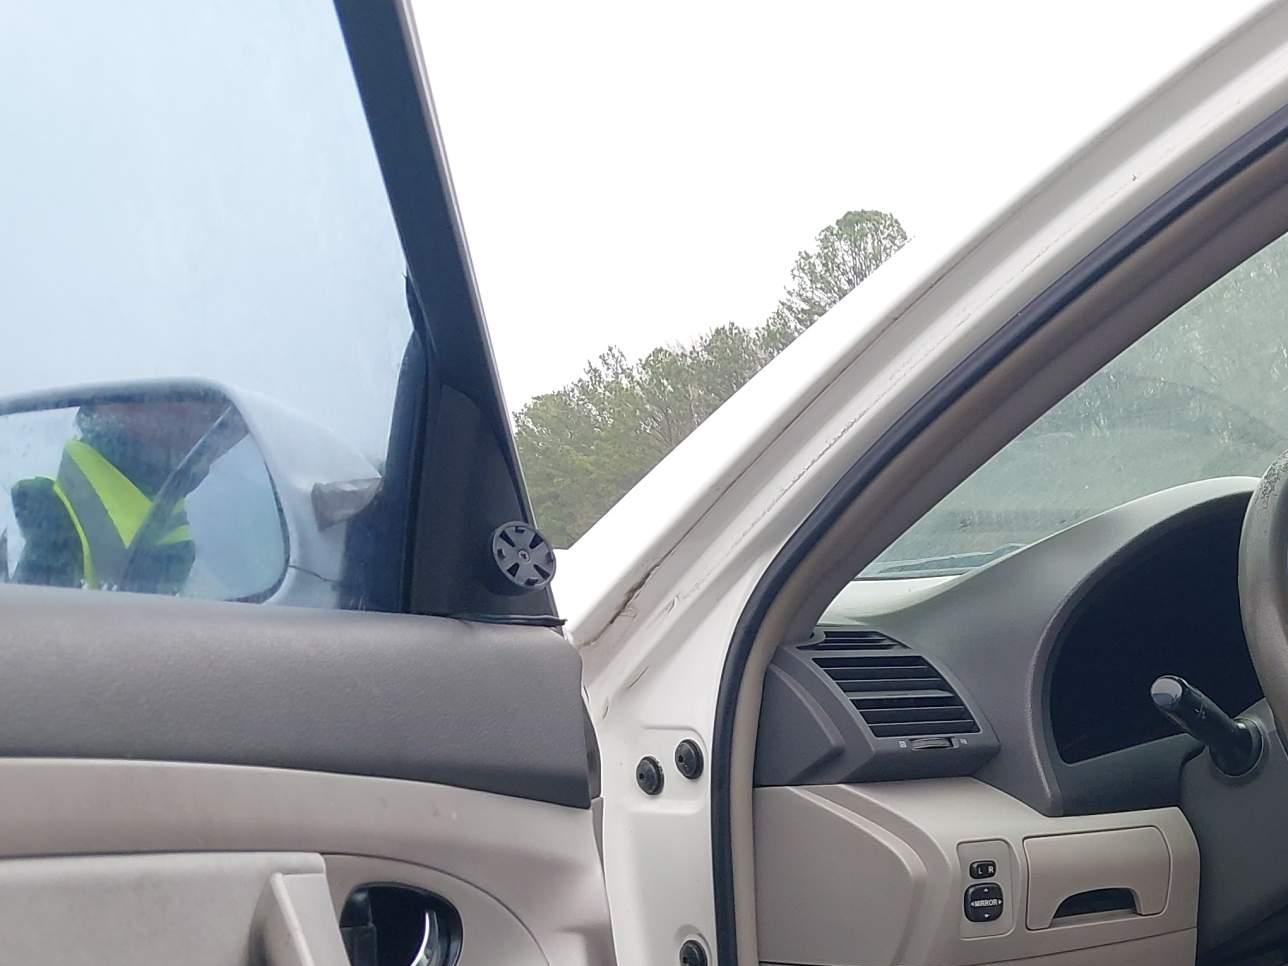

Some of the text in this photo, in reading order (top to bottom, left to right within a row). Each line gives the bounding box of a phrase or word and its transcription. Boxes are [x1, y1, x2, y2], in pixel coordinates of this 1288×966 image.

[978, 865, 994, 875] L R
[974, 898, 998, 907] MIRROR
